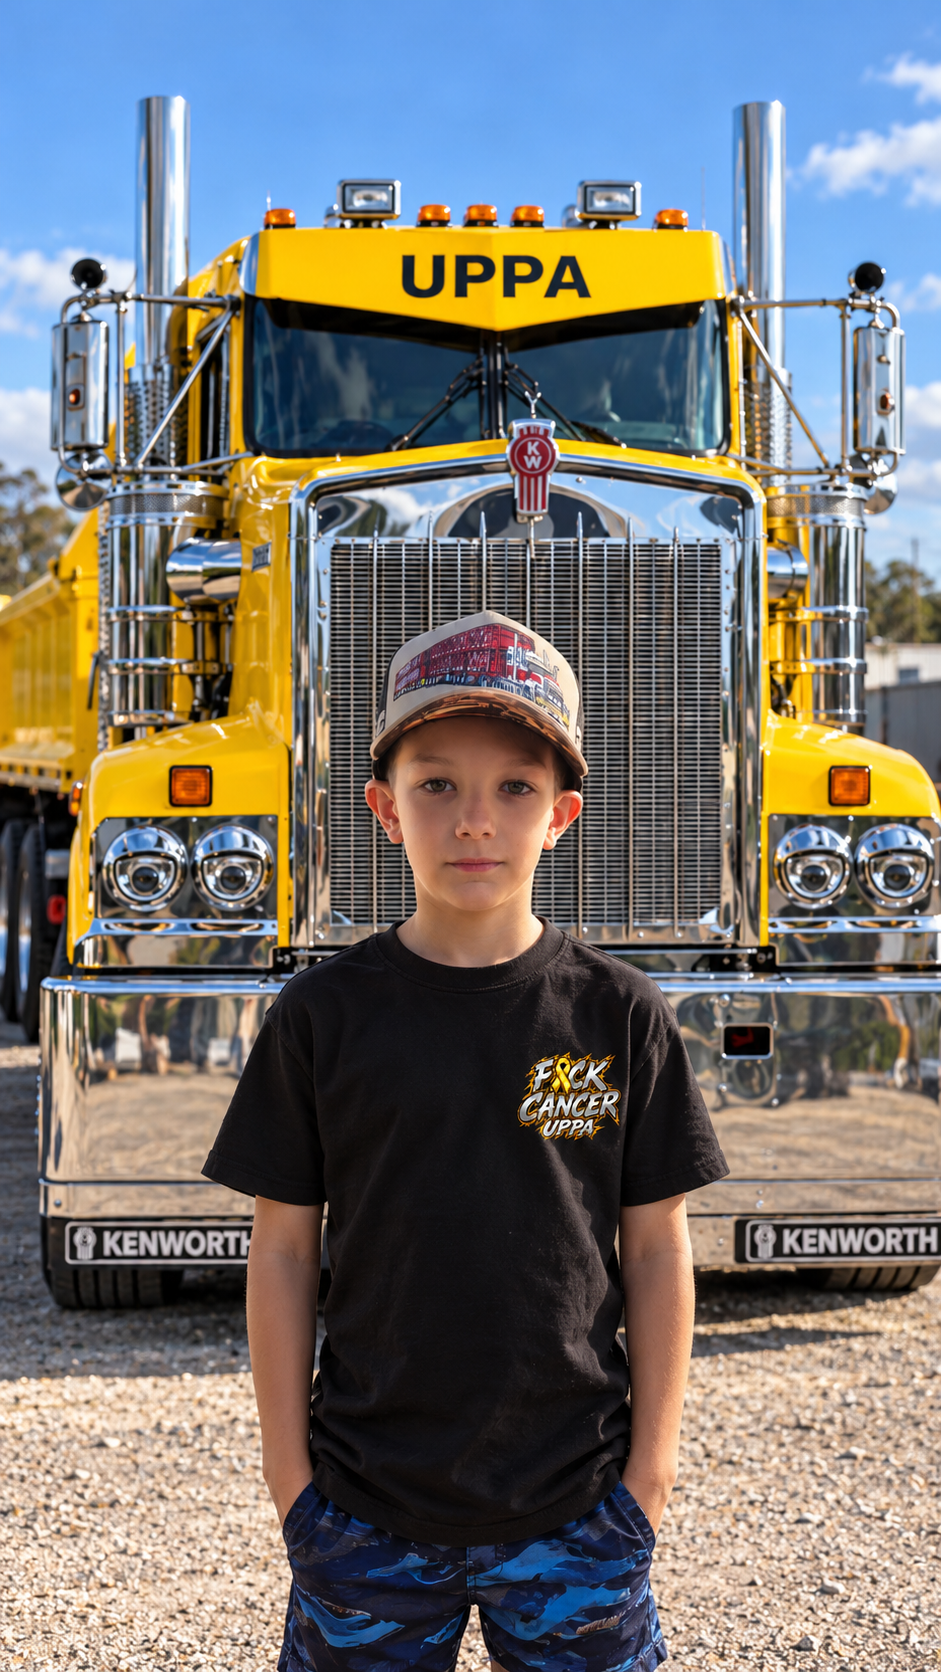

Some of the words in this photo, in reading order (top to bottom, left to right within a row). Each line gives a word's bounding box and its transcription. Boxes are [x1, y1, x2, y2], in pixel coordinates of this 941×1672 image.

[402, 255, 592, 298] UPPA
[533, 1058, 609, 1093] FCK
[519, 1090, 620, 1122] CANCER
[542, 1119, 594, 1138] UPPA
[782, 1227, 939, 1255] KENWORTH
